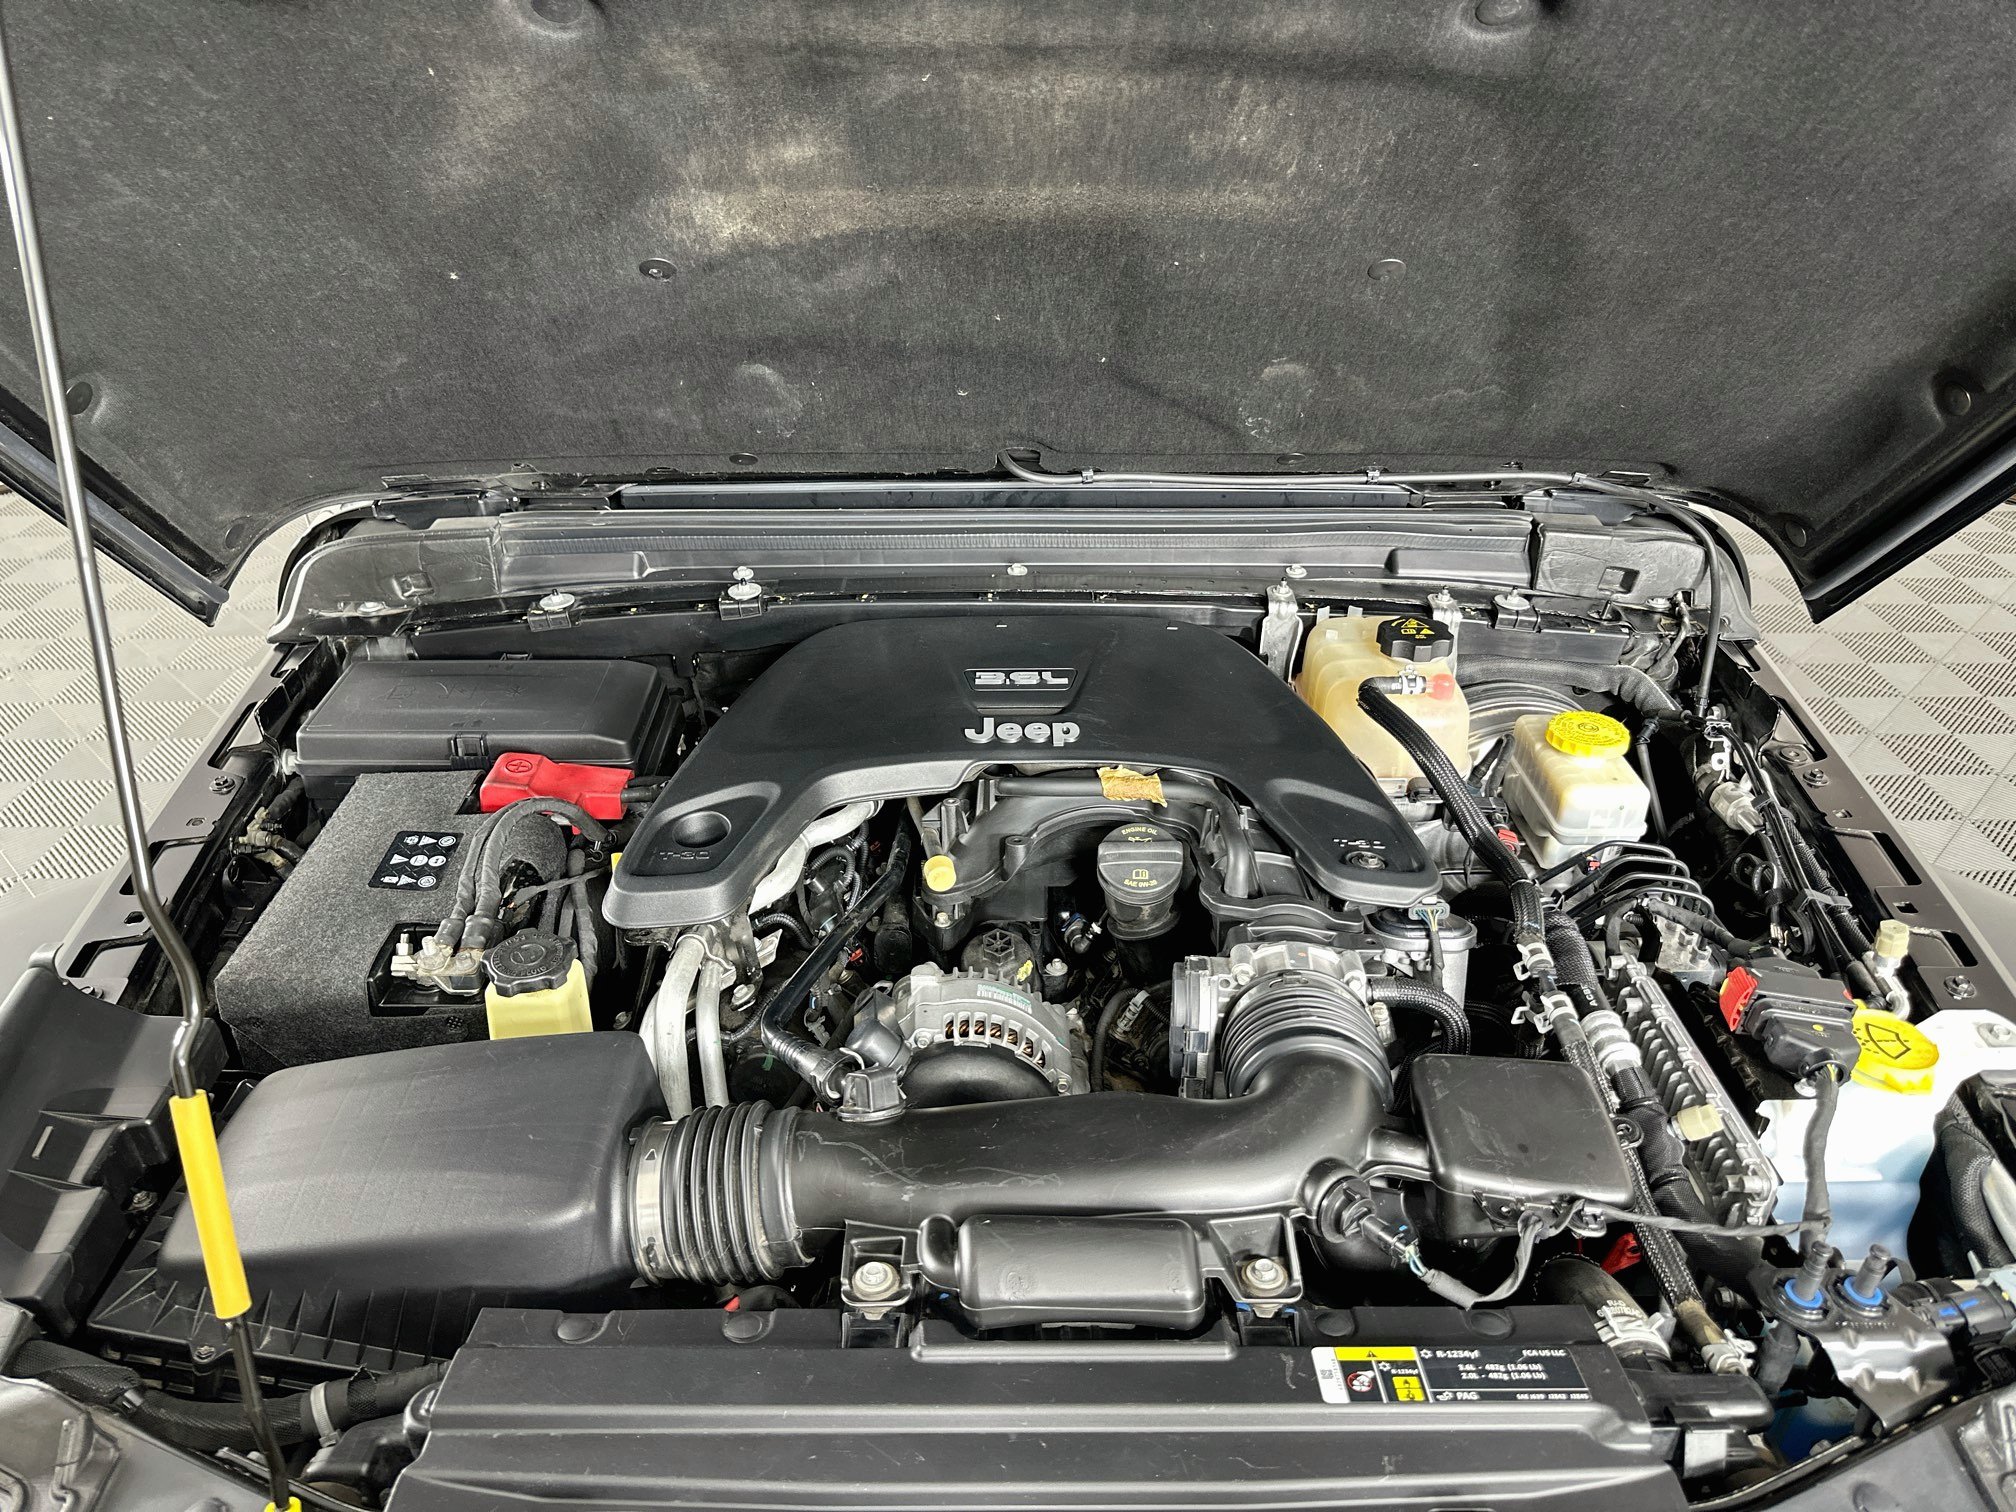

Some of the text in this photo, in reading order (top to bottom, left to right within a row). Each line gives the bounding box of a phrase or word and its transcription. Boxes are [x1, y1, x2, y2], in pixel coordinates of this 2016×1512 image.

[964, 717, 1081, 746] Jeep
[1121, 827, 1158, 836] ENGINE OIL
[1540, 1349, 1550, 1357] US
[1456, 1391, 1480, 1400] PAG
